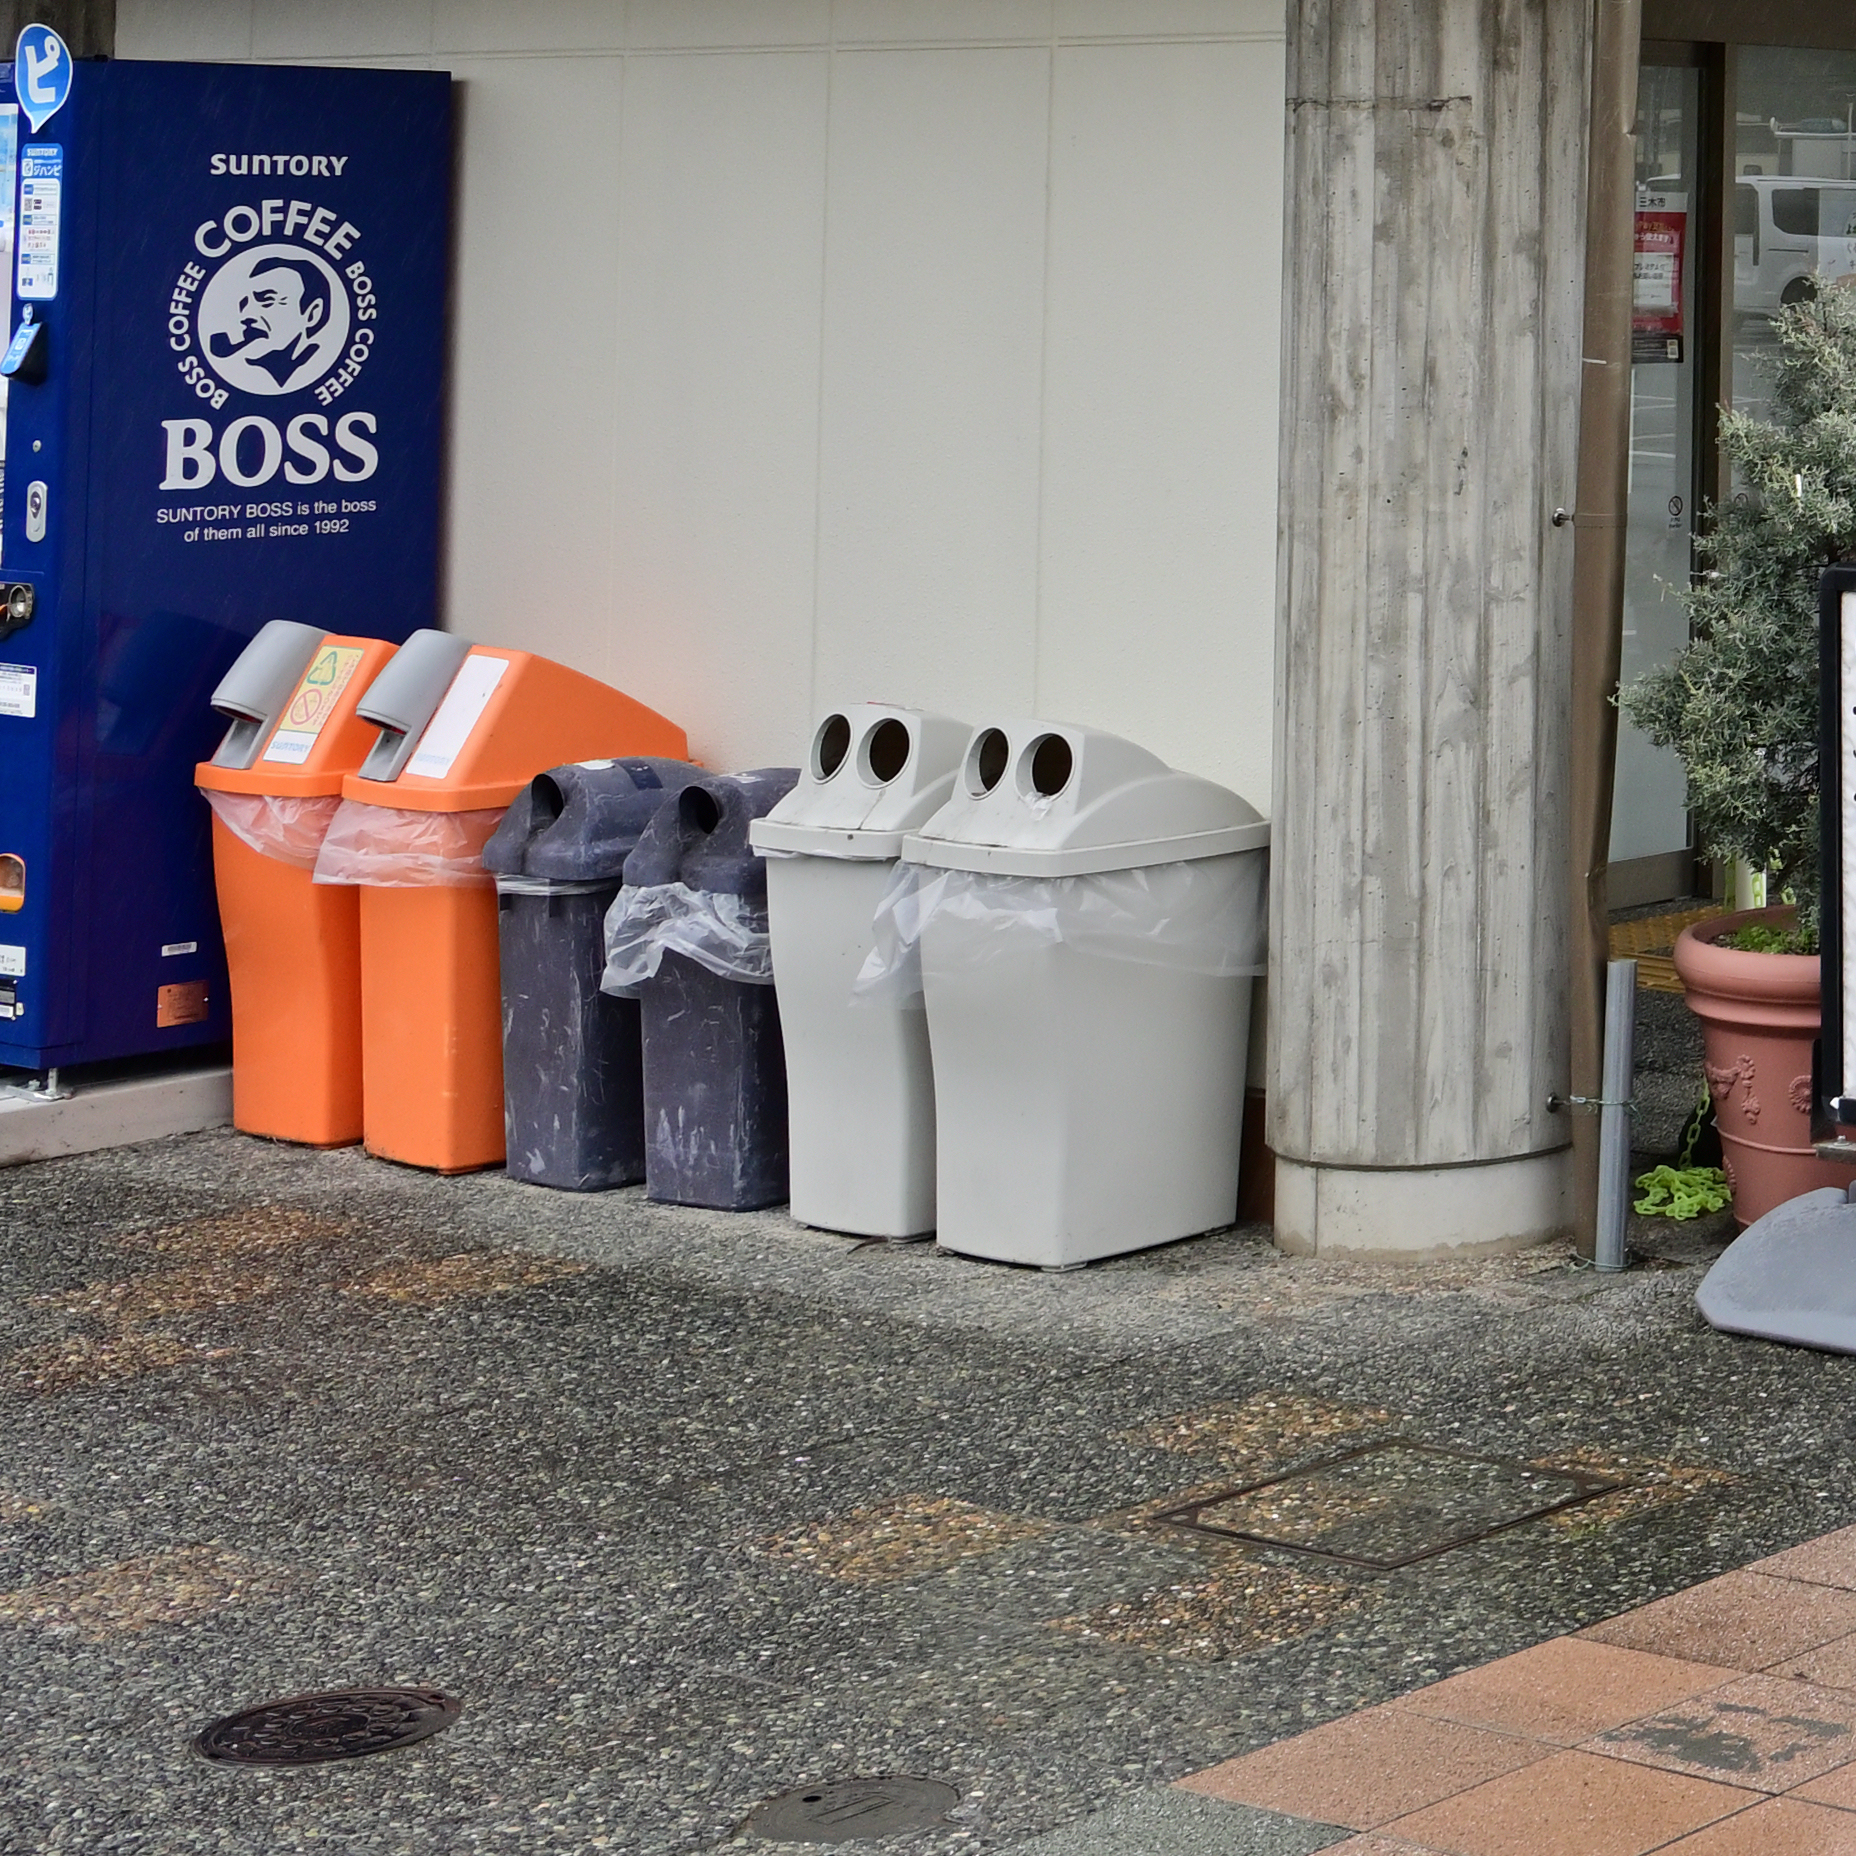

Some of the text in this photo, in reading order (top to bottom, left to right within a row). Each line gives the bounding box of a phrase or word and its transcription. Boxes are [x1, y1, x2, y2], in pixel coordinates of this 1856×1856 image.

[210, 153, 349, 176] SUNTORY
[1639, 197, 1666, 207] 三木市
[194, 199, 362, 261] COFFEE
[168, 261, 230, 410] BOSS COFFEE
[314, 260, 377, 406] BOSS COFFEE
[158, 411, 379, 490] BOSS
[156, 499, 377, 523] SUNTORY BOSS is the boss
[184, 519, 350, 542] of them all since 1992
